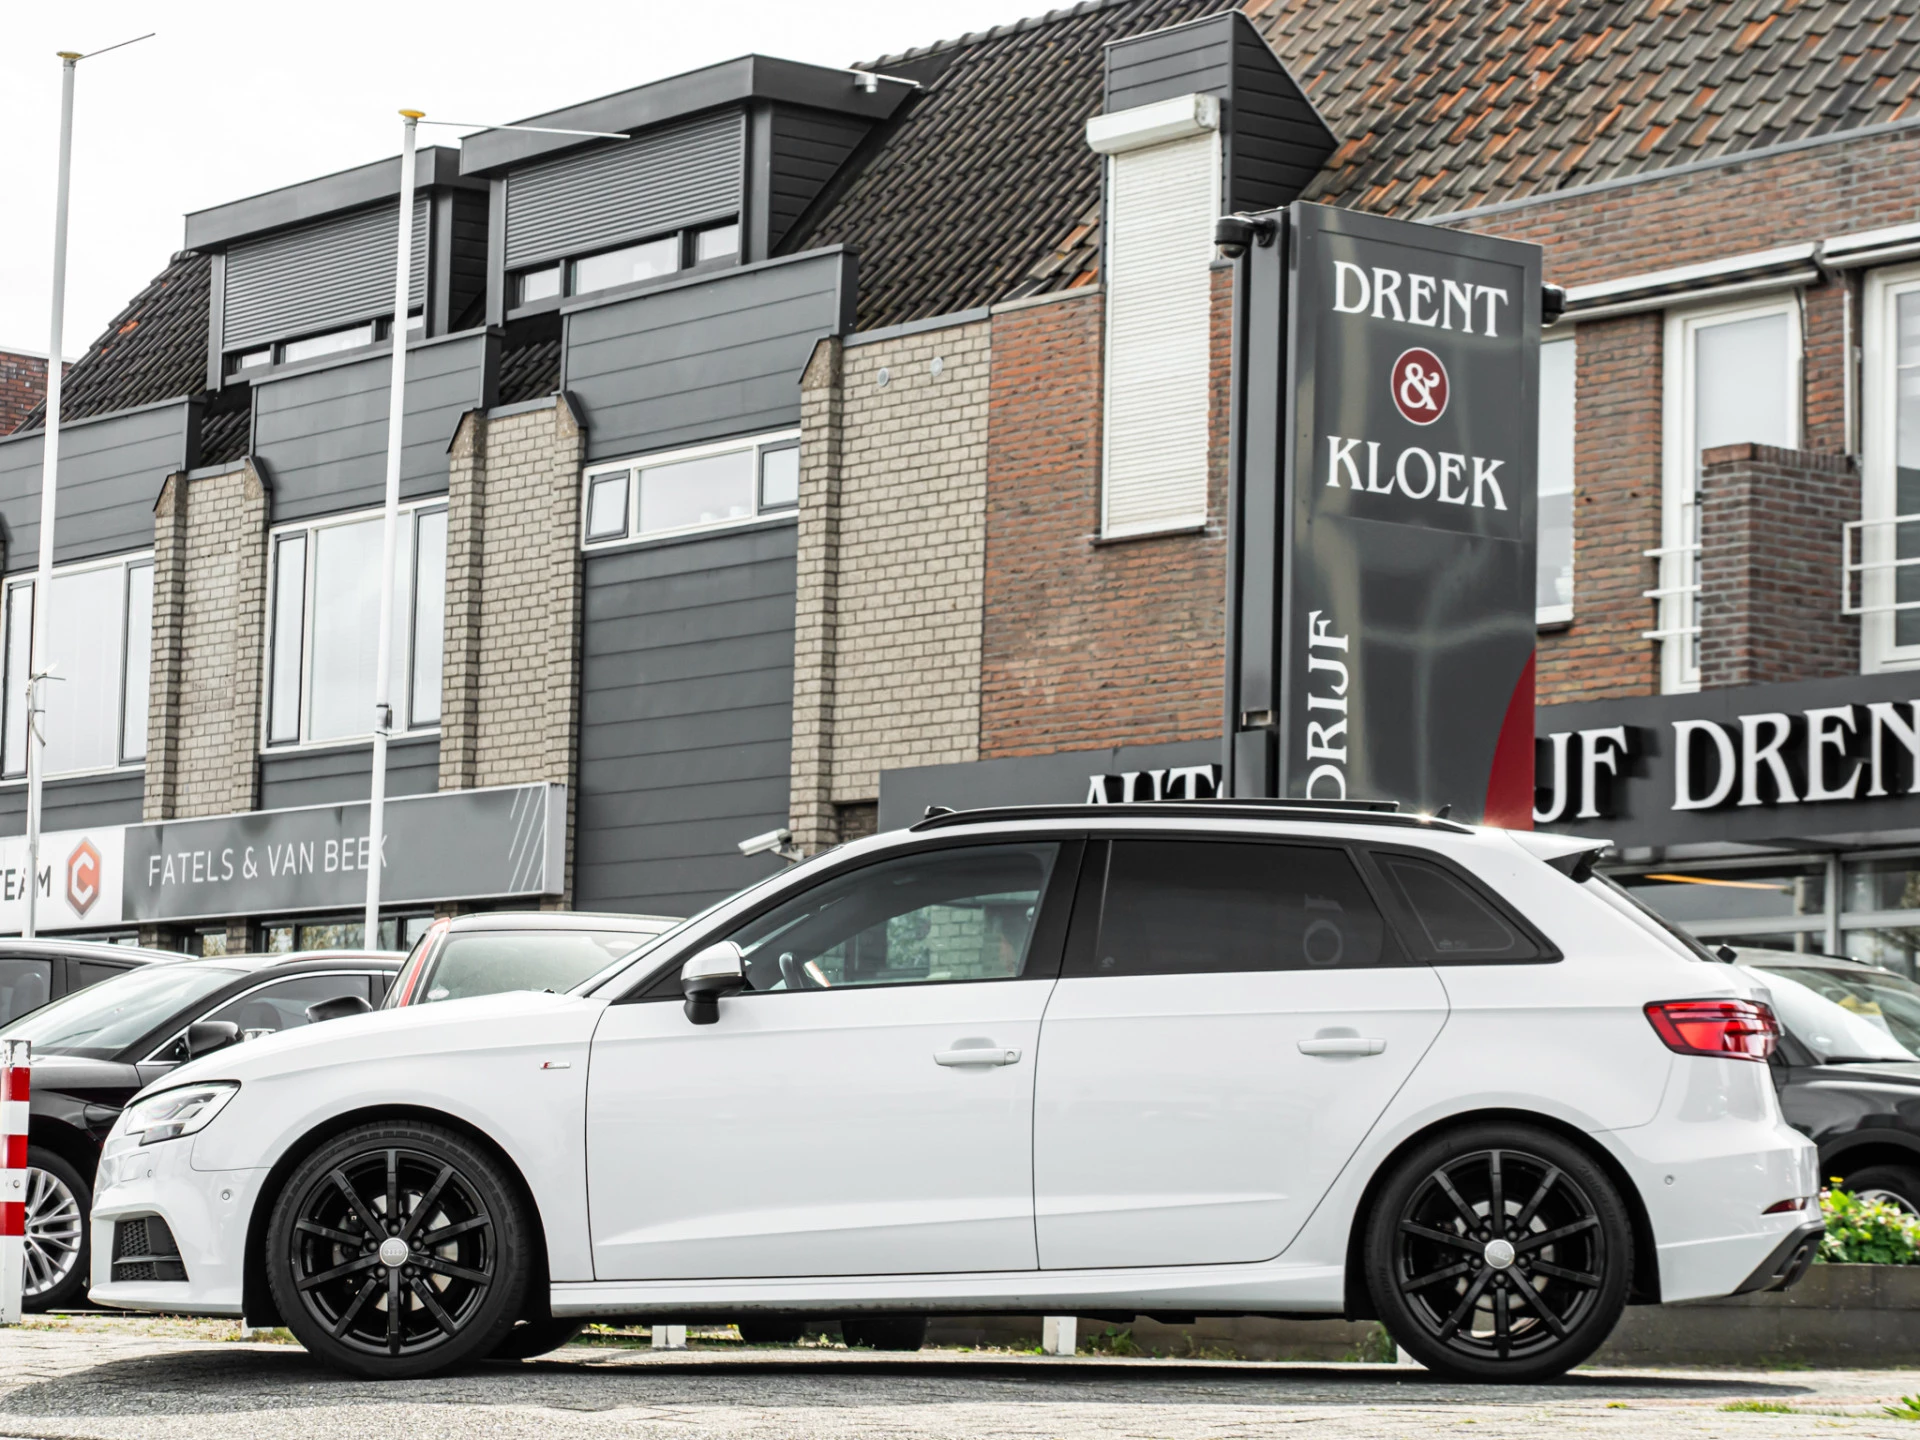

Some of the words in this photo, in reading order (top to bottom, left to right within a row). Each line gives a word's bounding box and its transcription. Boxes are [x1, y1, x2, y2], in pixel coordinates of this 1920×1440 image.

[1333, 260, 1509, 338] DRENT
[1400, 362, 1441, 411] &
[1326, 435, 1508, 511] KLOEK
[1671, 699, 1920, 811] DREN
[149, 848, 234, 887] FATELS
[242, 846, 258, 880] &
[267, 841, 314, 876] VAN
